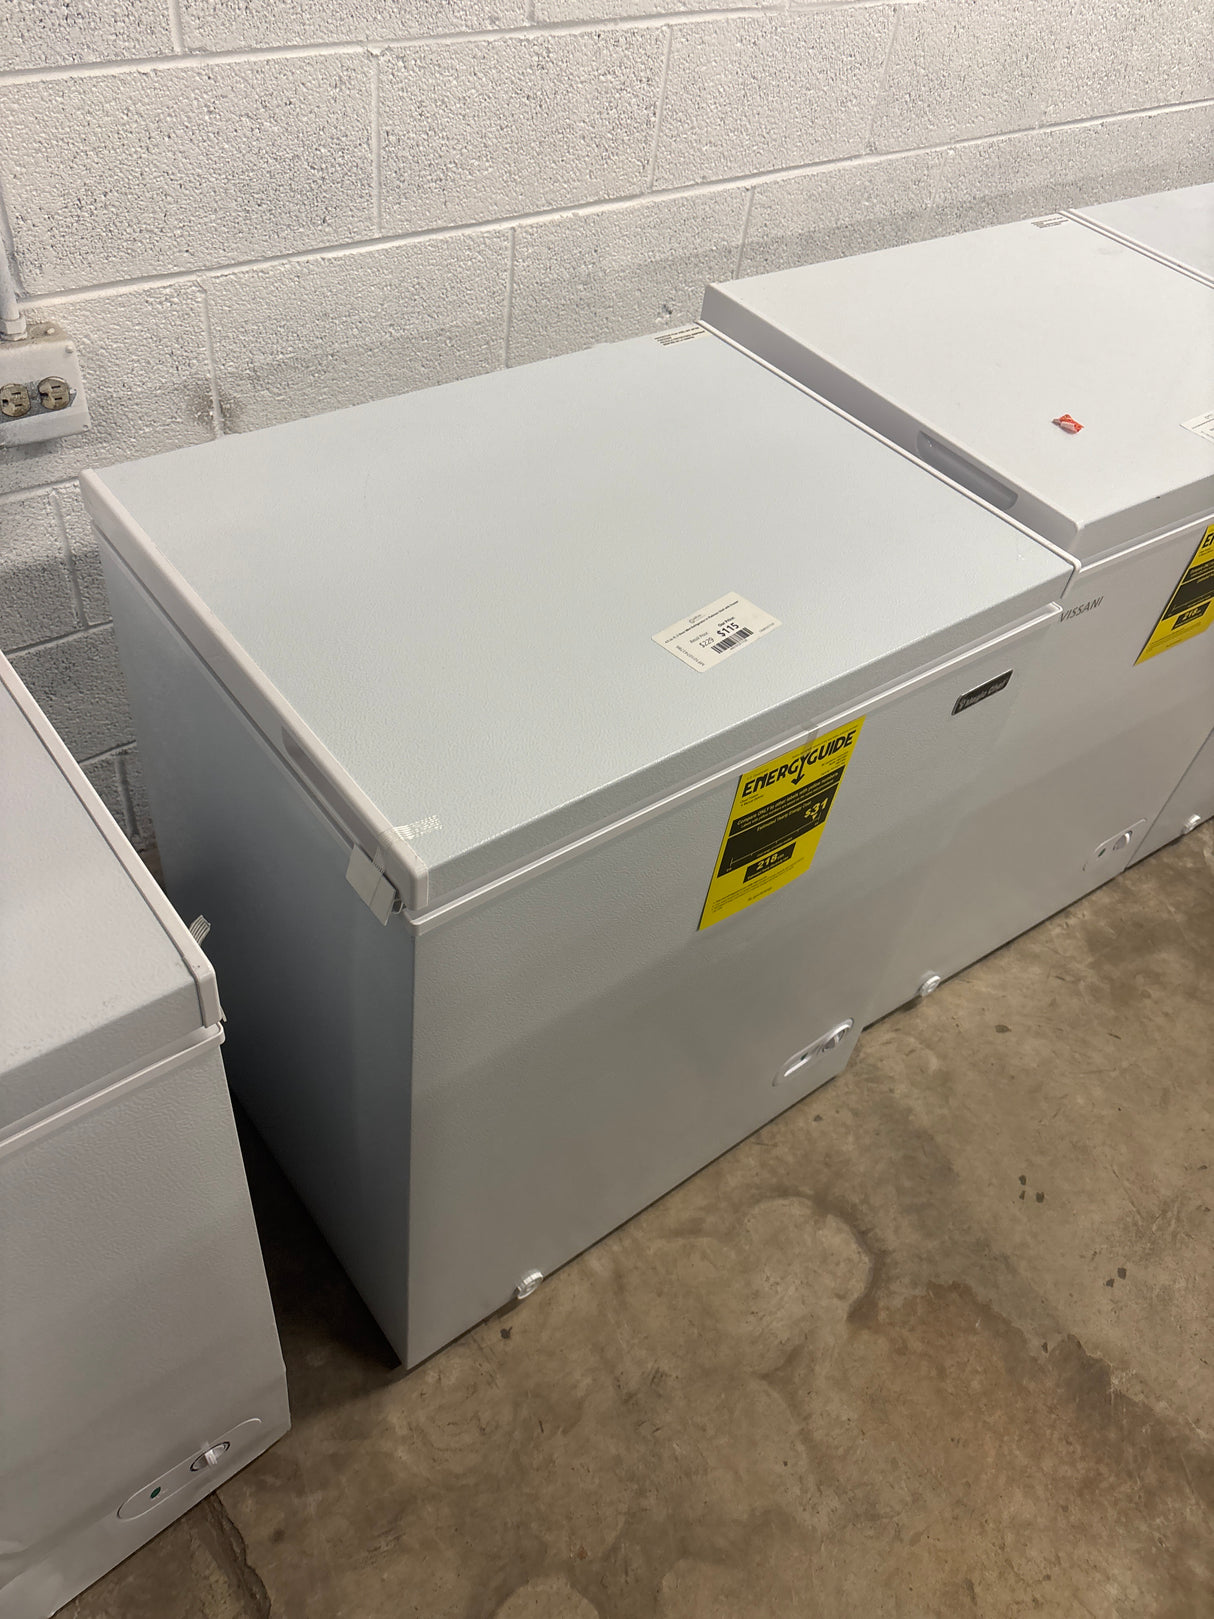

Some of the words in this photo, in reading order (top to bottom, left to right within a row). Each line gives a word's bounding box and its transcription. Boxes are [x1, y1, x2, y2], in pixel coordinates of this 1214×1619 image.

[1060, 596, 1104, 622] VISSANI
[716, 622, 739, 637] $115
[742, 730, 856, 798] ENERGYGUIDE
[804, 797, 828, 818] $31
[756, 853, 778, 870] 218
